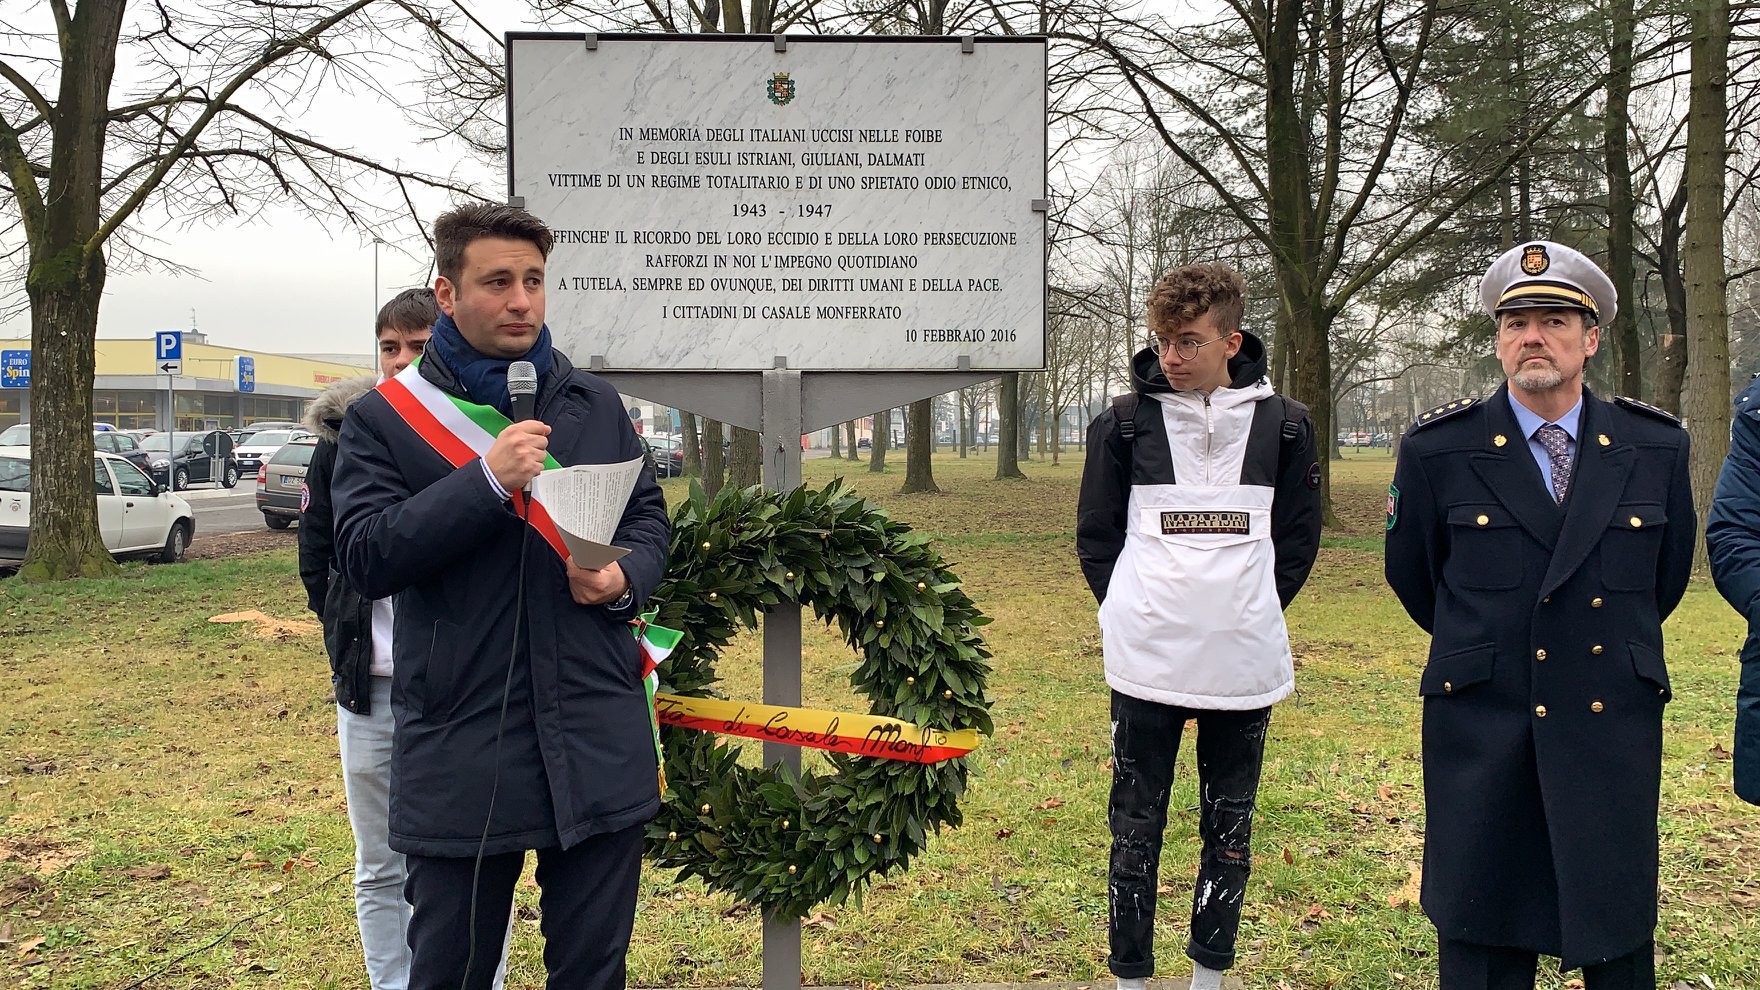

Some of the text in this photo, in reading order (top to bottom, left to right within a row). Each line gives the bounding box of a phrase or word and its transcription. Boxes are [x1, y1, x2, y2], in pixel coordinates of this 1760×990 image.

[619, 127, 942, 143] IN MEMORIA DEGLI ITALIANI UCCISI NELLE FOIBE
[637, 151, 925, 169] E DEGLI ESULI ISTRIANI, GIULIANI, DALMATI
[548, 174, 1011, 192] VITTIME DI UN REGIME TOTALITARIO E DI UNO SPIETATO ODIO ETNICO,
[733, 204, 766, 217] 1943
[798, 204, 832, 217] 1947
[552, 230, 1017, 245] FFINCHE' IL RICORDO DEL LORO ECCIDIO E DELLA LORO PERSECUZIONE
[646, 254, 917, 271] RAFFORZI IN NOI L'IMPEGNO QUOTIDIANO
[558, 277, 1002, 294] A TUTELA, SEMPRE ED OVUNQUE, DEI DIRITTI UMANI E DELLA PACE.
[663, 306, 901, 319] I CITTADINI DI CASALE MONFERRATO
[906, 329, 1016, 342] 10 FEBBRAIO 2016
[161, 334, 177, 358] P
[9, 358, 28, 366] EURO
[6, 366, 30, 380] Spin
[1164, 513, 1248, 528] NAPAPIJRI
[722, 706, 750, 734] di
